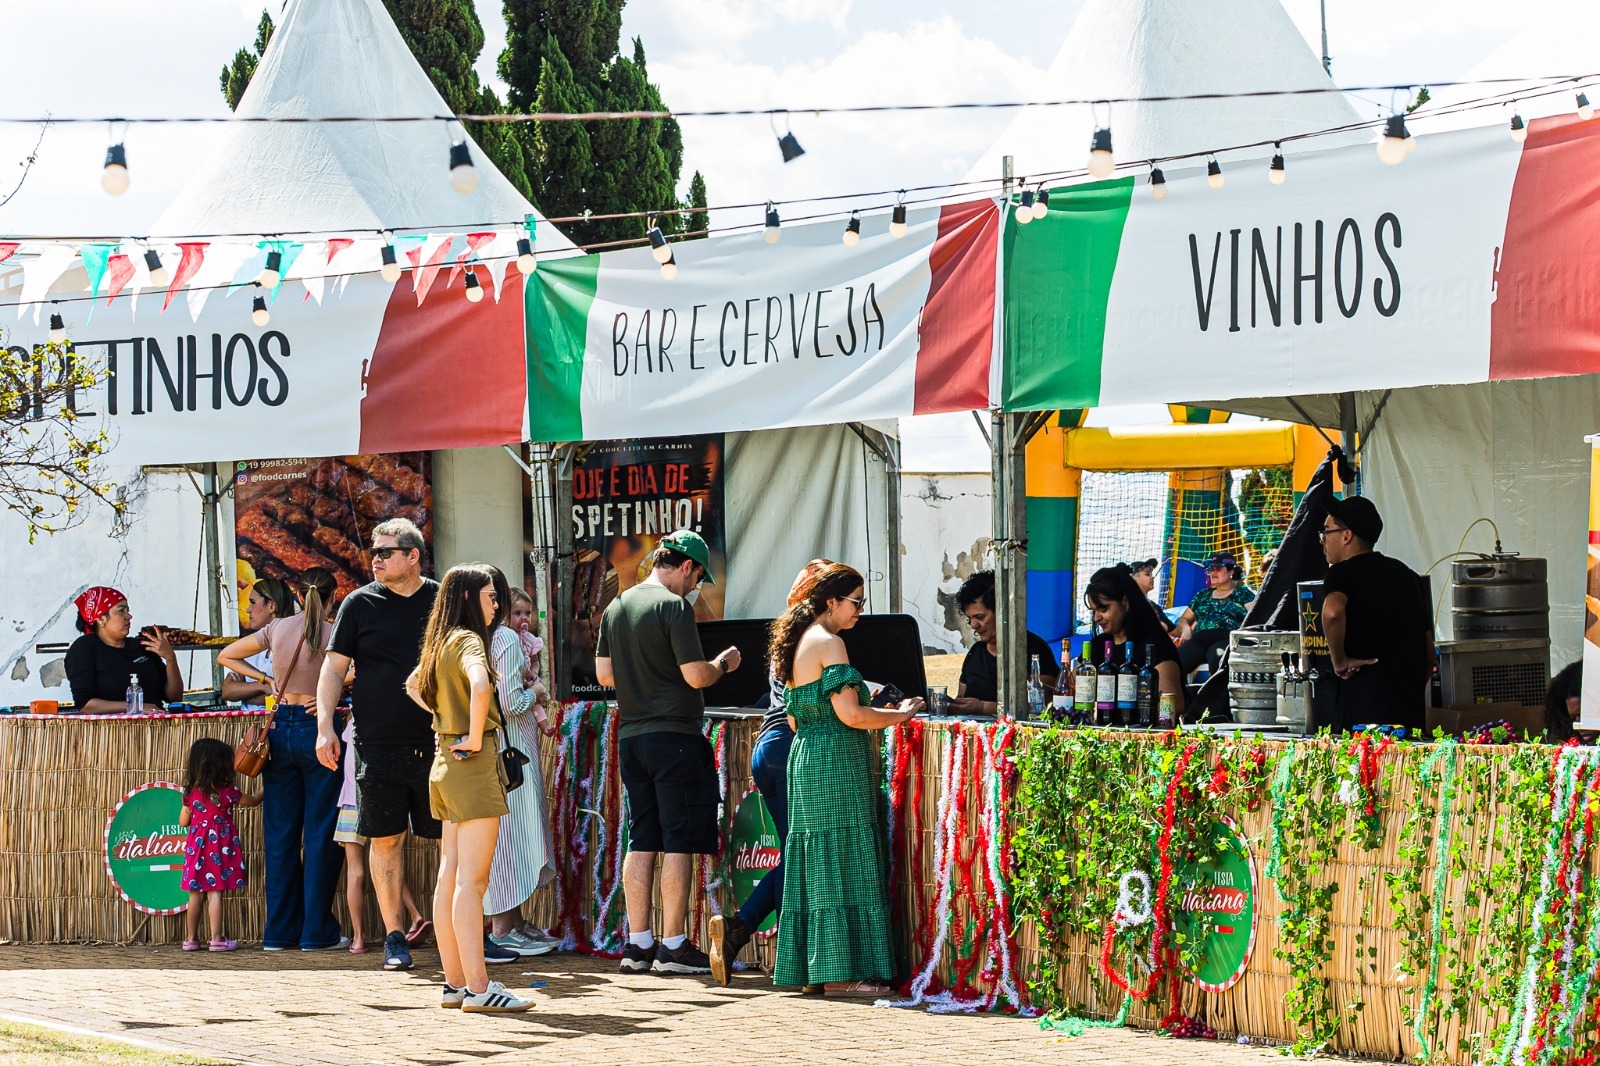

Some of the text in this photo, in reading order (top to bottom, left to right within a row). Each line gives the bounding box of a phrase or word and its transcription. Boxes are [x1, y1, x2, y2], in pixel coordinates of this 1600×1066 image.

[1188, 211, 1402, 333] VINHOS
[612, 282, 885, 377] BAR E CERVEJA
[0, 330, 291, 420] SPETINHOS
[248, 458, 308, 469] 19 99982-5941
[250, 471, 307, 483] @foodcarnes
[610, 461, 621, 497] É
[628, 464, 659, 496] DIA
[664, 463, 690, 494] DE
